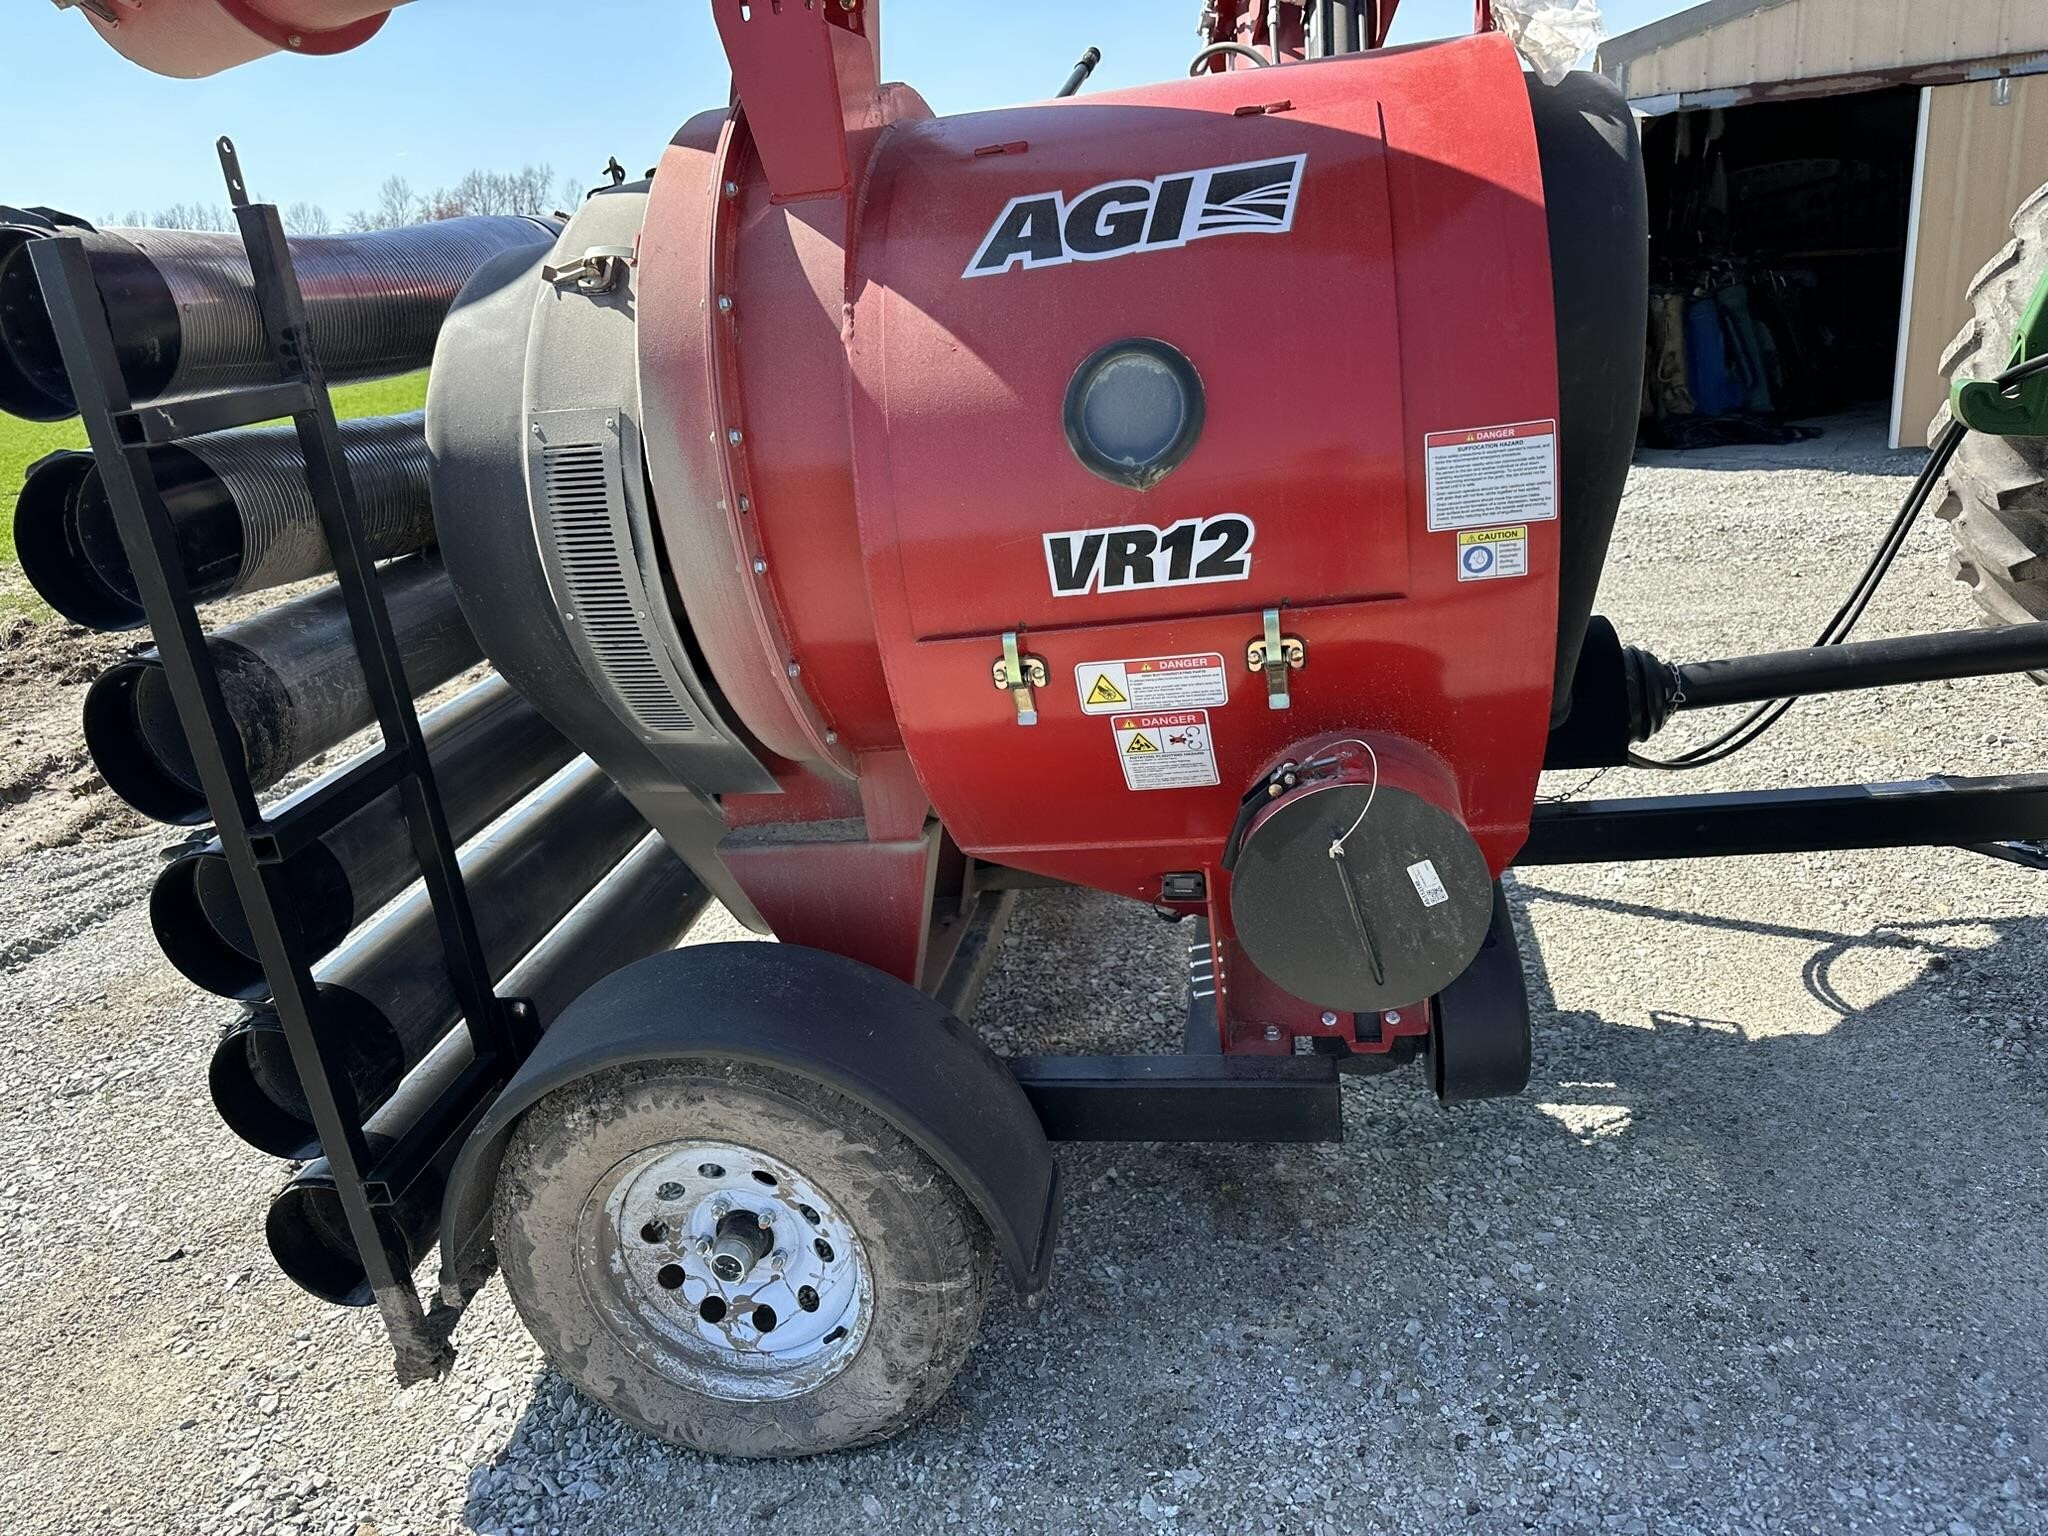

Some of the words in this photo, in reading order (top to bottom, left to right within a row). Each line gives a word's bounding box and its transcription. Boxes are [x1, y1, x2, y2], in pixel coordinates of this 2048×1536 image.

[975, 176, 1194, 270] AGI
[1476, 428, 1515, 440] DANGER
[1457, 441, 1498, 452] SUFFOCATION
[1499, 439, 1524, 447] HAZARD
[1477, 530, 1518, 541] CAUTION
[1049, 519, 1249, 591] VR12
[1159, 658, 1208, 670] DANGER
[1141, 714, 1196, 726] DANGER
